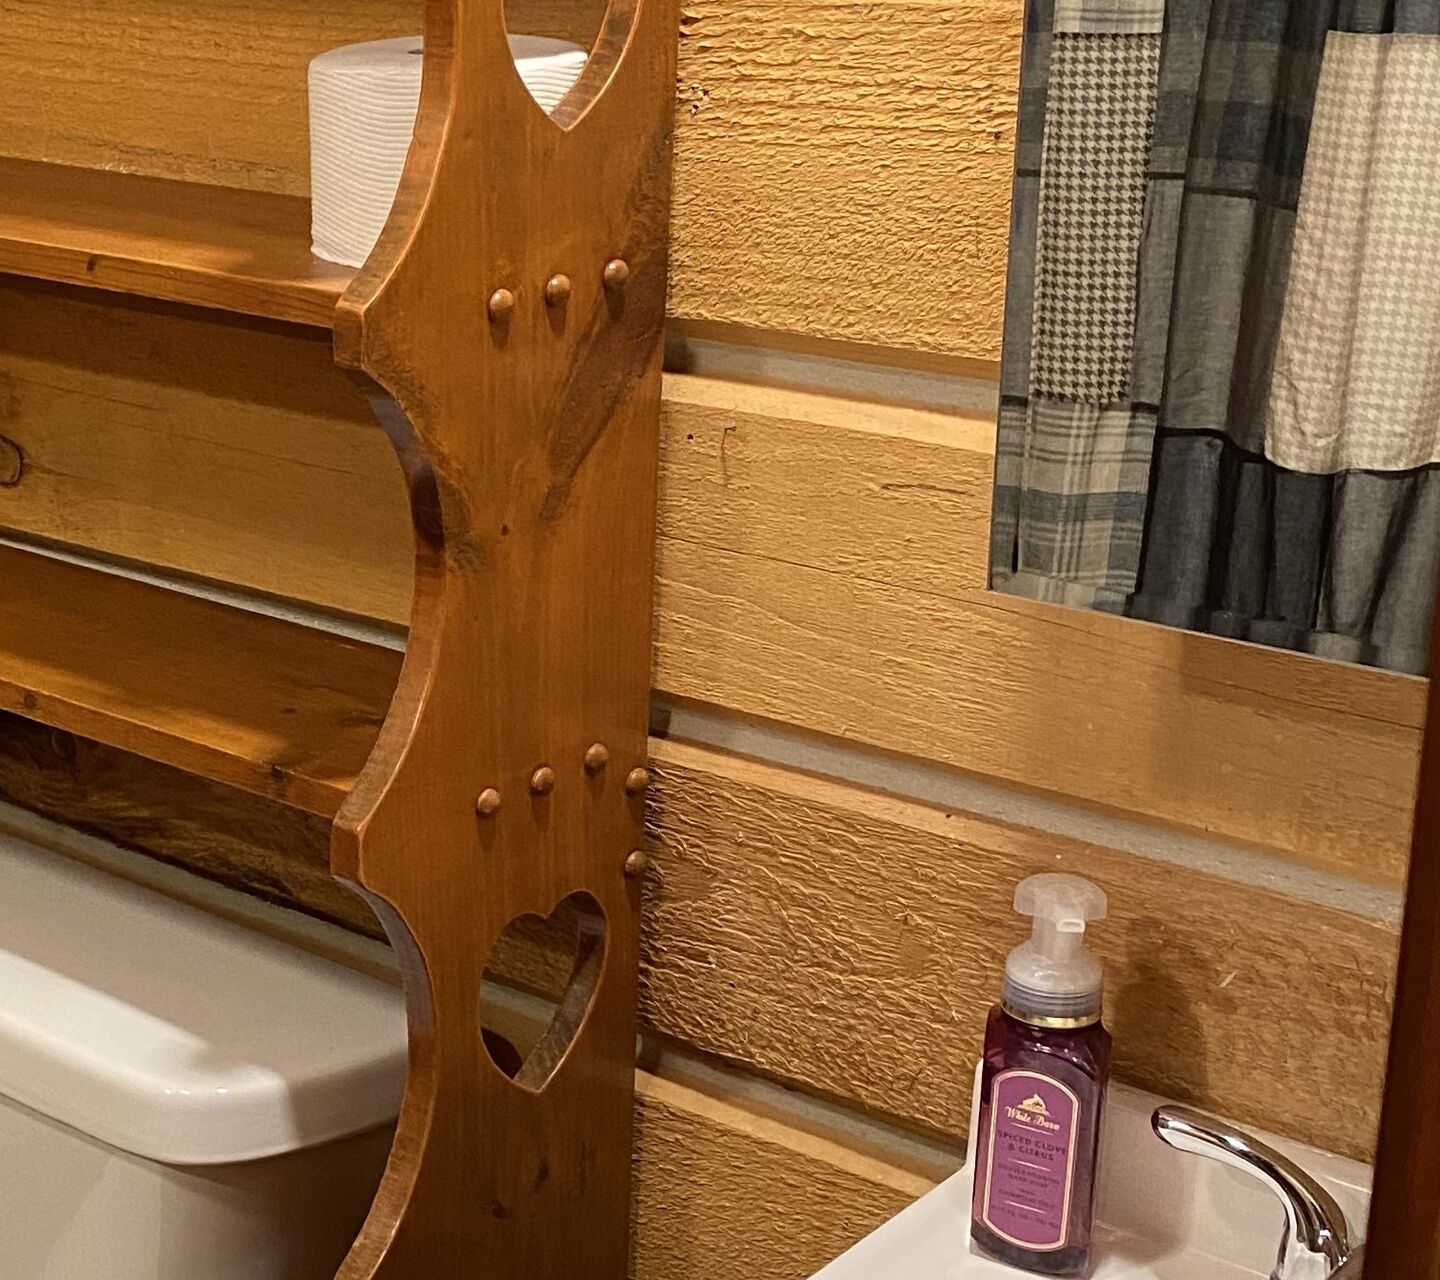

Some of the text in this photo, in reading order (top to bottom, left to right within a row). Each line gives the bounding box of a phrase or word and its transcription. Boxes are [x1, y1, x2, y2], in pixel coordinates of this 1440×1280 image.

[1005, 1106, 1061, 1131] White Barn
[998, 1130, 1032, 1146] SPICED
[1019, 1145, 1054, 1161] CITRUS
